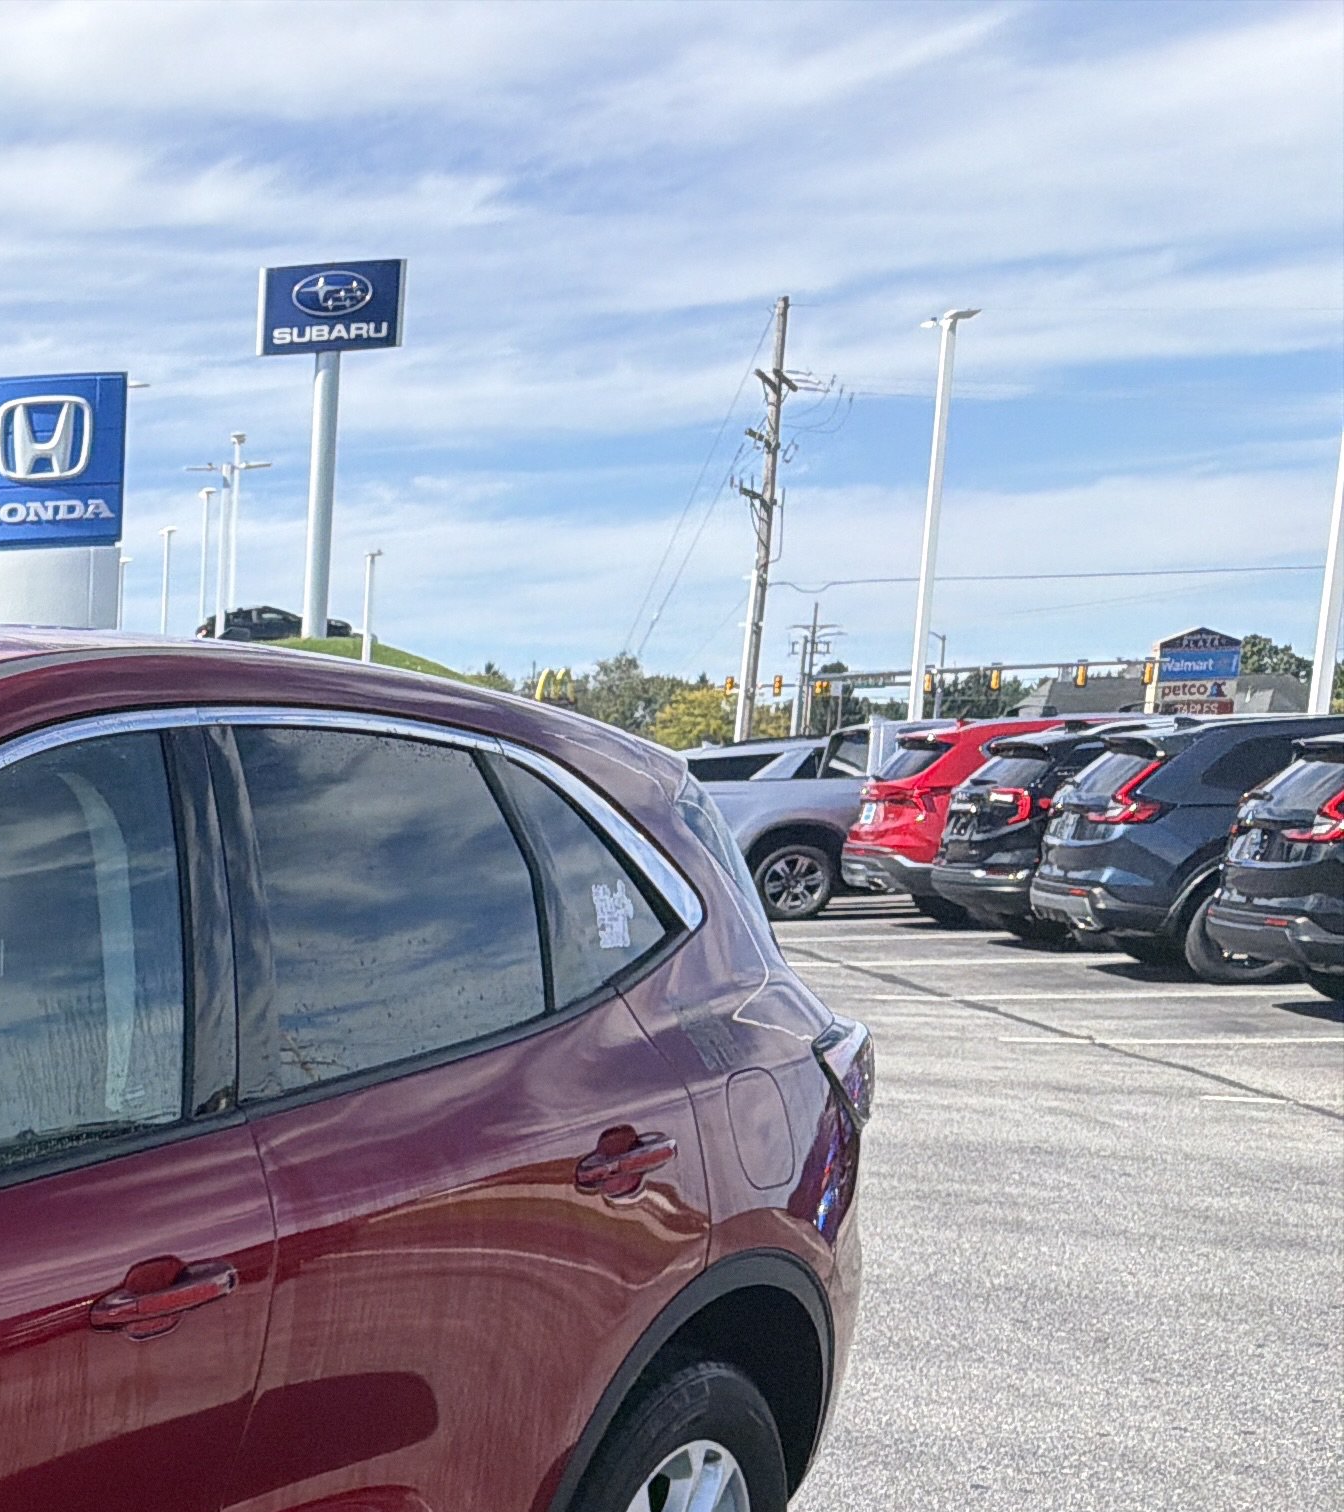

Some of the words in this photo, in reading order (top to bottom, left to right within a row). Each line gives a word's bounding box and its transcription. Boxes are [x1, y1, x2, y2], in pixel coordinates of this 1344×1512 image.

[272, 321, 388, 345] SUBARU
[1162, 657, 1214, 672] Walmart
[1161, 683, 1208, 699] petco
[1174, 703, 1219, 714] TAPLES
